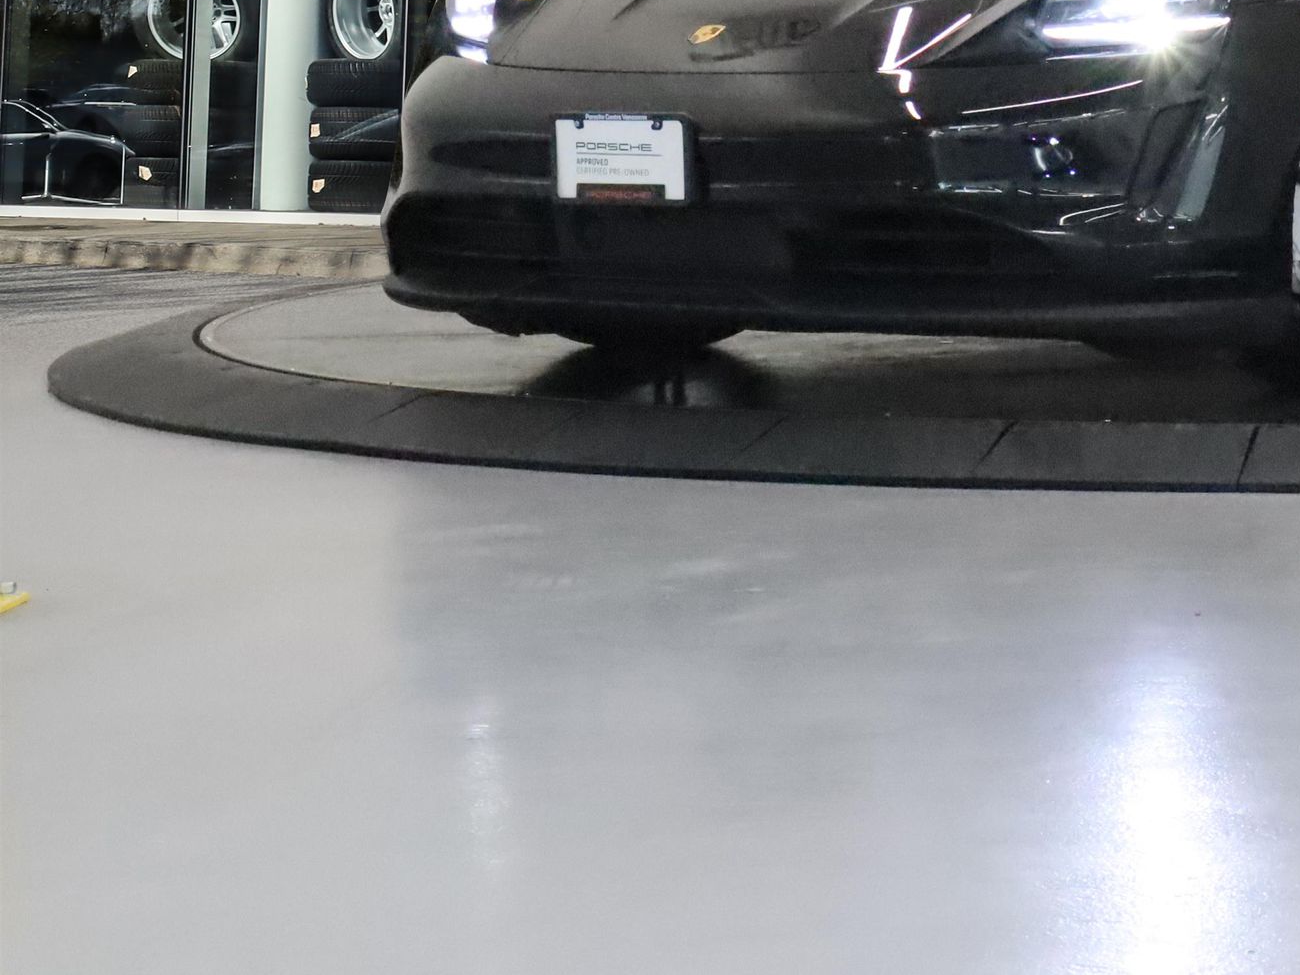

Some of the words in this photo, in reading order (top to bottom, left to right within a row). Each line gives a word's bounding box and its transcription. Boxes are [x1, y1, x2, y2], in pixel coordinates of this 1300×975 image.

[576, 141, 653, 151] PORSCHE
[576, 158, 609, 166] APPROVED
[576, 167, 608, 175] CERTIFIED
